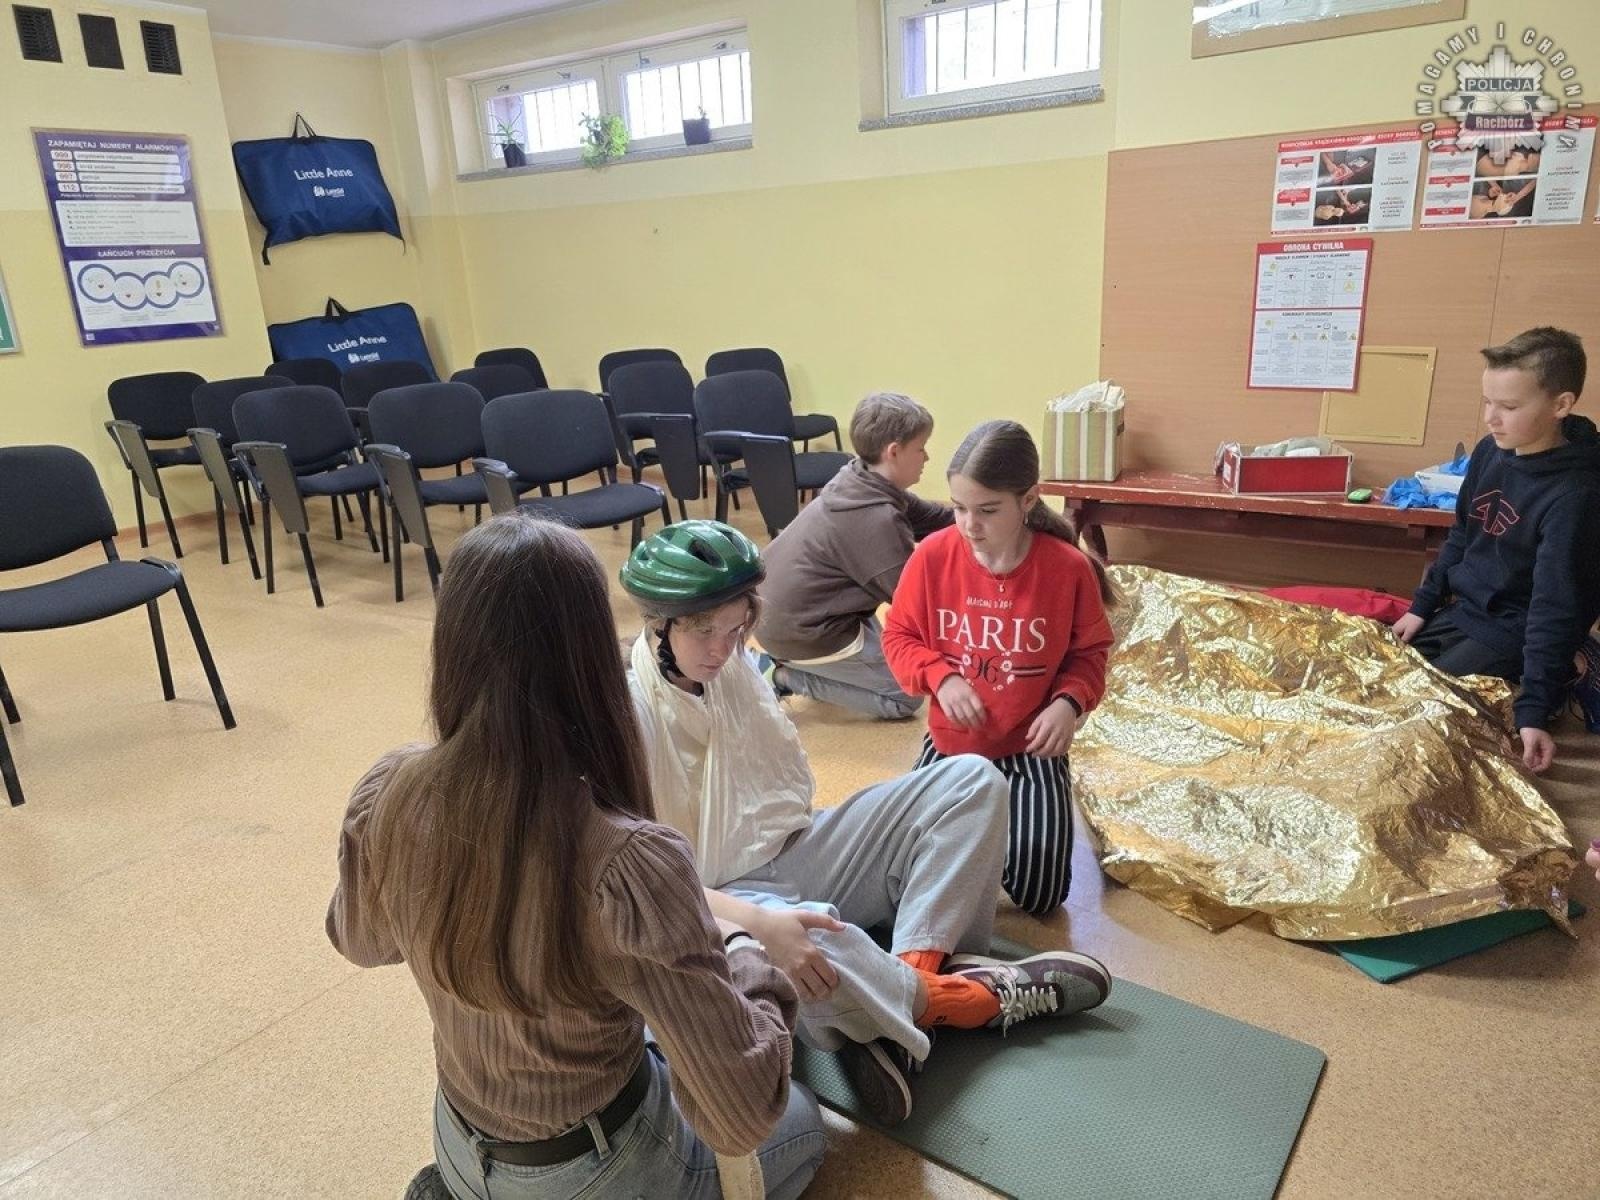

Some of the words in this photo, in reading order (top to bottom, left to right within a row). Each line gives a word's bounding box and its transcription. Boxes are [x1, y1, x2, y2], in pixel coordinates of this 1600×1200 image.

[294, 168, 325, 180] Little
[326, 167, 353, 177] Anne
[327, 338, 359, 352] Little
[359, 336, 388, 345] Anne
[936, 608, 1046, 652] PARIS
